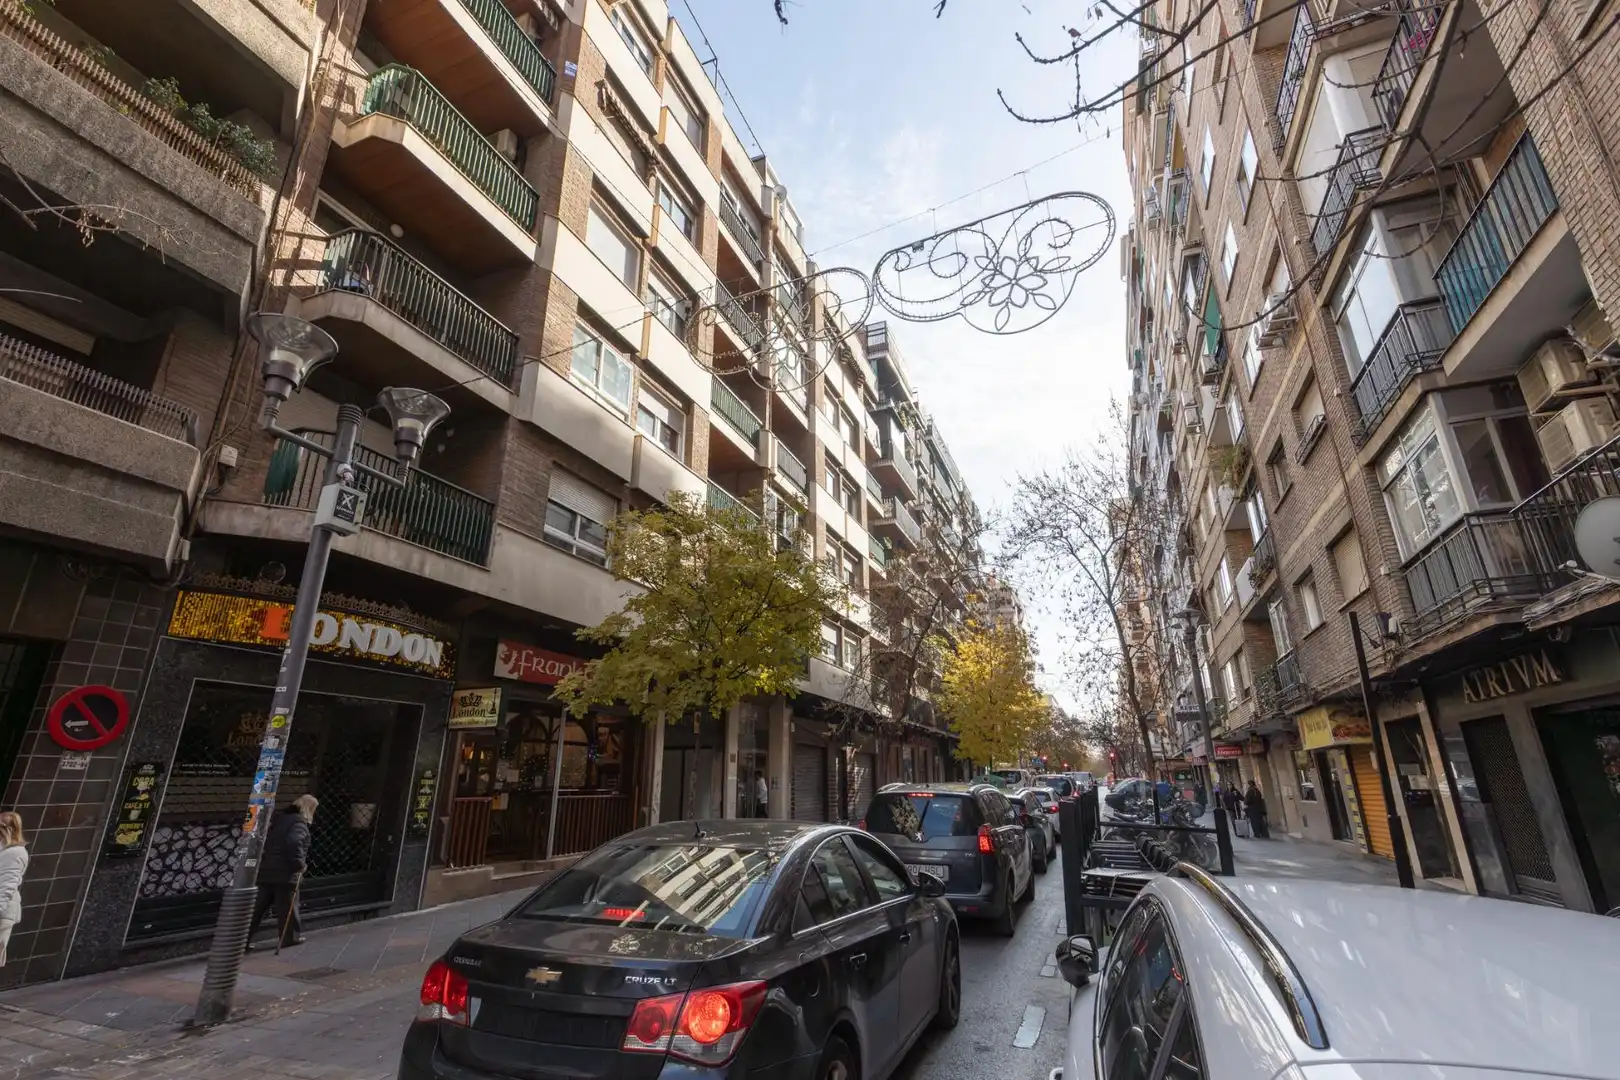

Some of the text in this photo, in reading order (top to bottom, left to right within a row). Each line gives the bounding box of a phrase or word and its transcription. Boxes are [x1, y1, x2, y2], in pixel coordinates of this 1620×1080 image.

[260, 606, 443, 668] LONDON
[1461, 648, 1562, 704] ATRIVM
[451, 706, 487, 718] London
[624, 975, 677, 987] CRUZE LT
